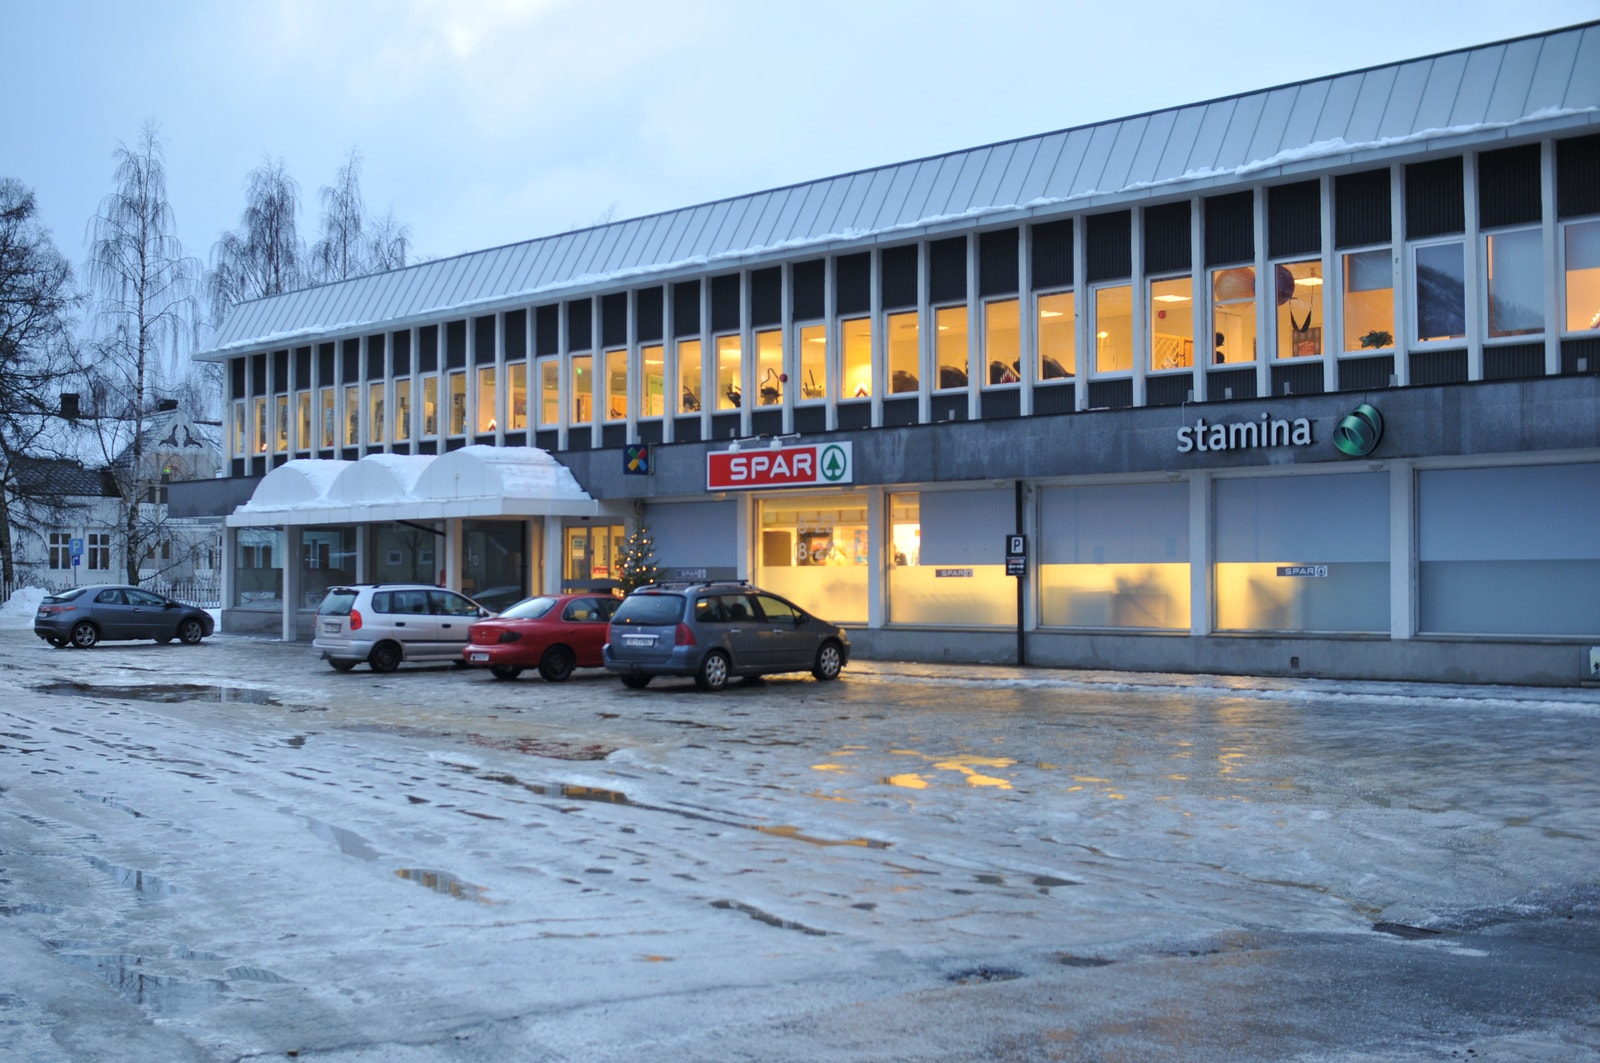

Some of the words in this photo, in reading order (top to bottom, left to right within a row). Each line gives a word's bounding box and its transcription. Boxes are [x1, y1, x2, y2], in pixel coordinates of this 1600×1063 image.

[1176, 412, 1311, 452] stamina
[730, 453, 812, 481] SPAR
[1013, 538, 1021, 551] P
[1285, 567, 1314, 576] SPAR
